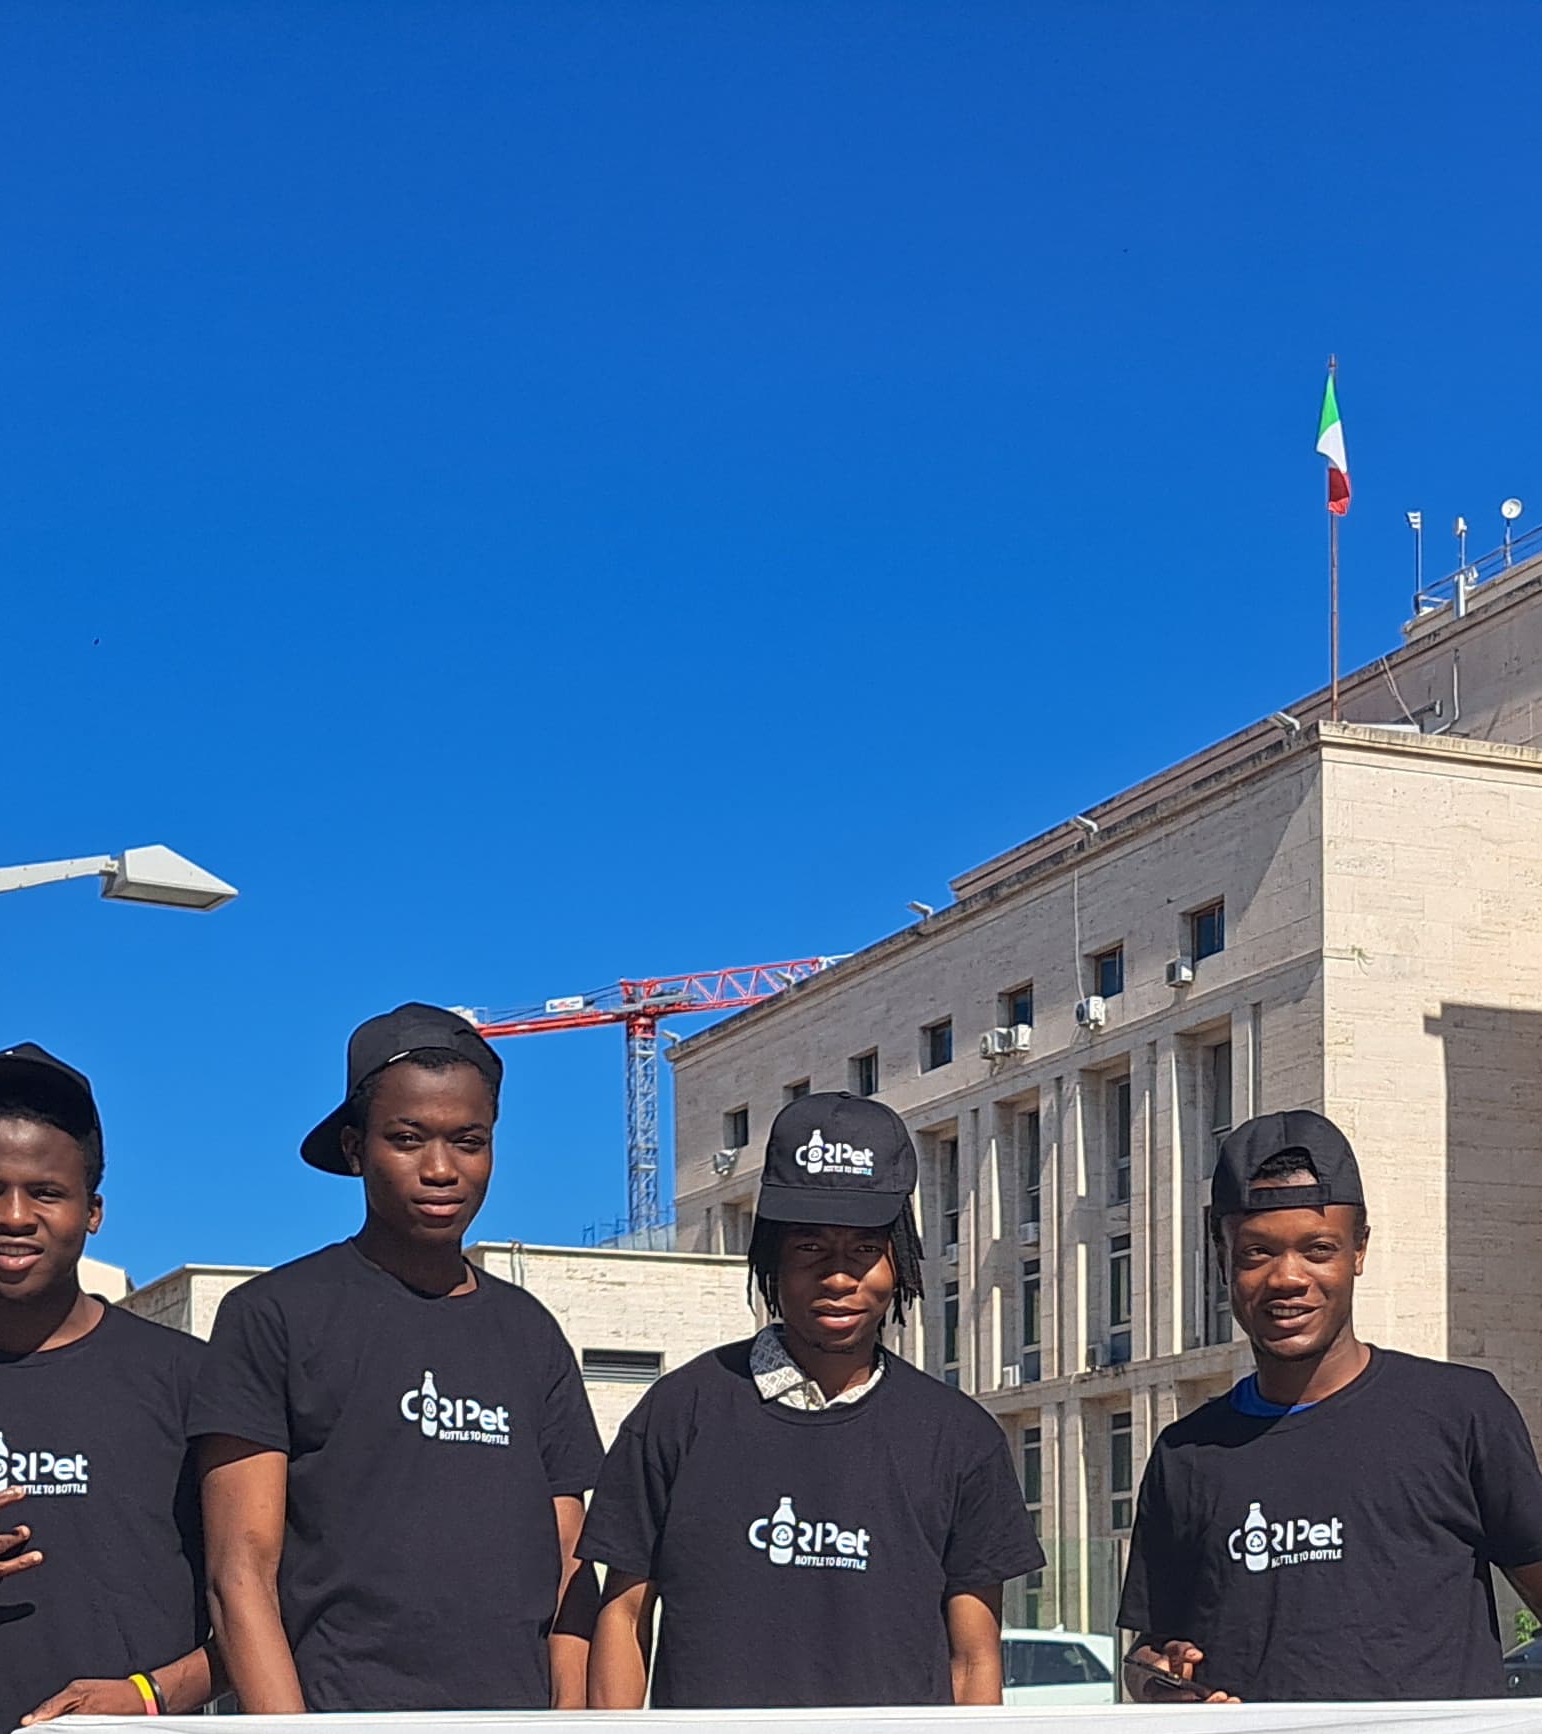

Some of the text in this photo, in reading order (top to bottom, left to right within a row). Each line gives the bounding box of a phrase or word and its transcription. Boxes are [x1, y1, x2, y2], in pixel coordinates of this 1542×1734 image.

[400, 1389, 510, 1433] CORIPet
[439, 1430, 469, 1441] BOTTLE
[470, 1430, 481, 1441] TO
[43, 1484, 55, 1495] TO
[55, 1482, 88, 1495] BOTTLE
[748, 1517, 870, 1557] CORIPet
[1227, 1516, 1343, 1560] CORIPet
[794, 1554, 867, 1571] BOTTLE TO BOTTLE
[1299, 1551, 1309, 1562] TO
[1309, 1548, 1342, 1560] BOTTLE
